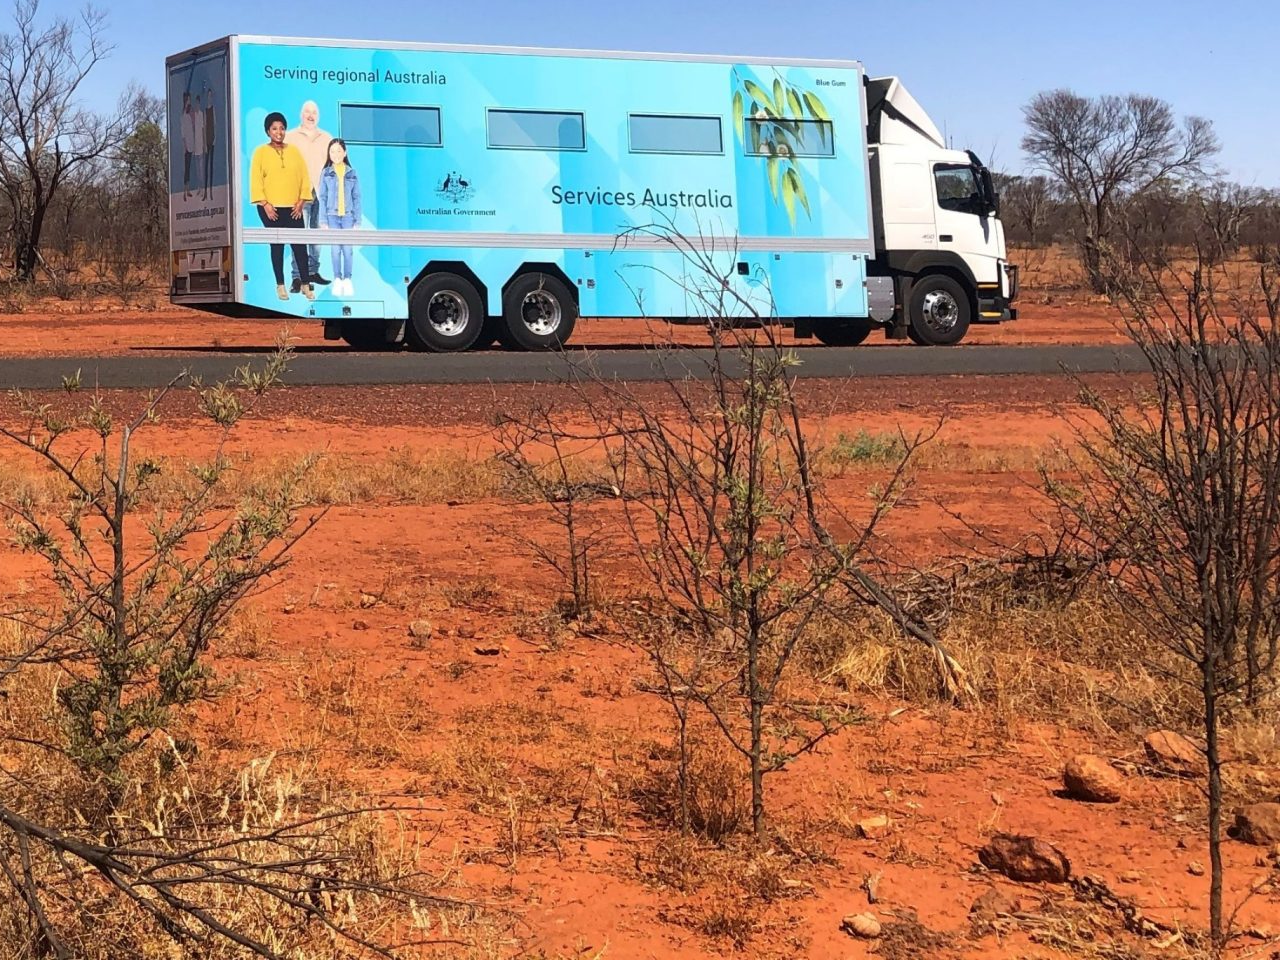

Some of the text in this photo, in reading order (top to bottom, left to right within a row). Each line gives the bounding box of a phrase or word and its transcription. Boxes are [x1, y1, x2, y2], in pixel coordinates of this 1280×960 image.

[264, 65, 447, 85] Serving regional Australia
[815, 79, 847, 87] Blue Gum
[551, 185, 733, 208] Services Australia
[416, 207, 497, 216] Australian Government
